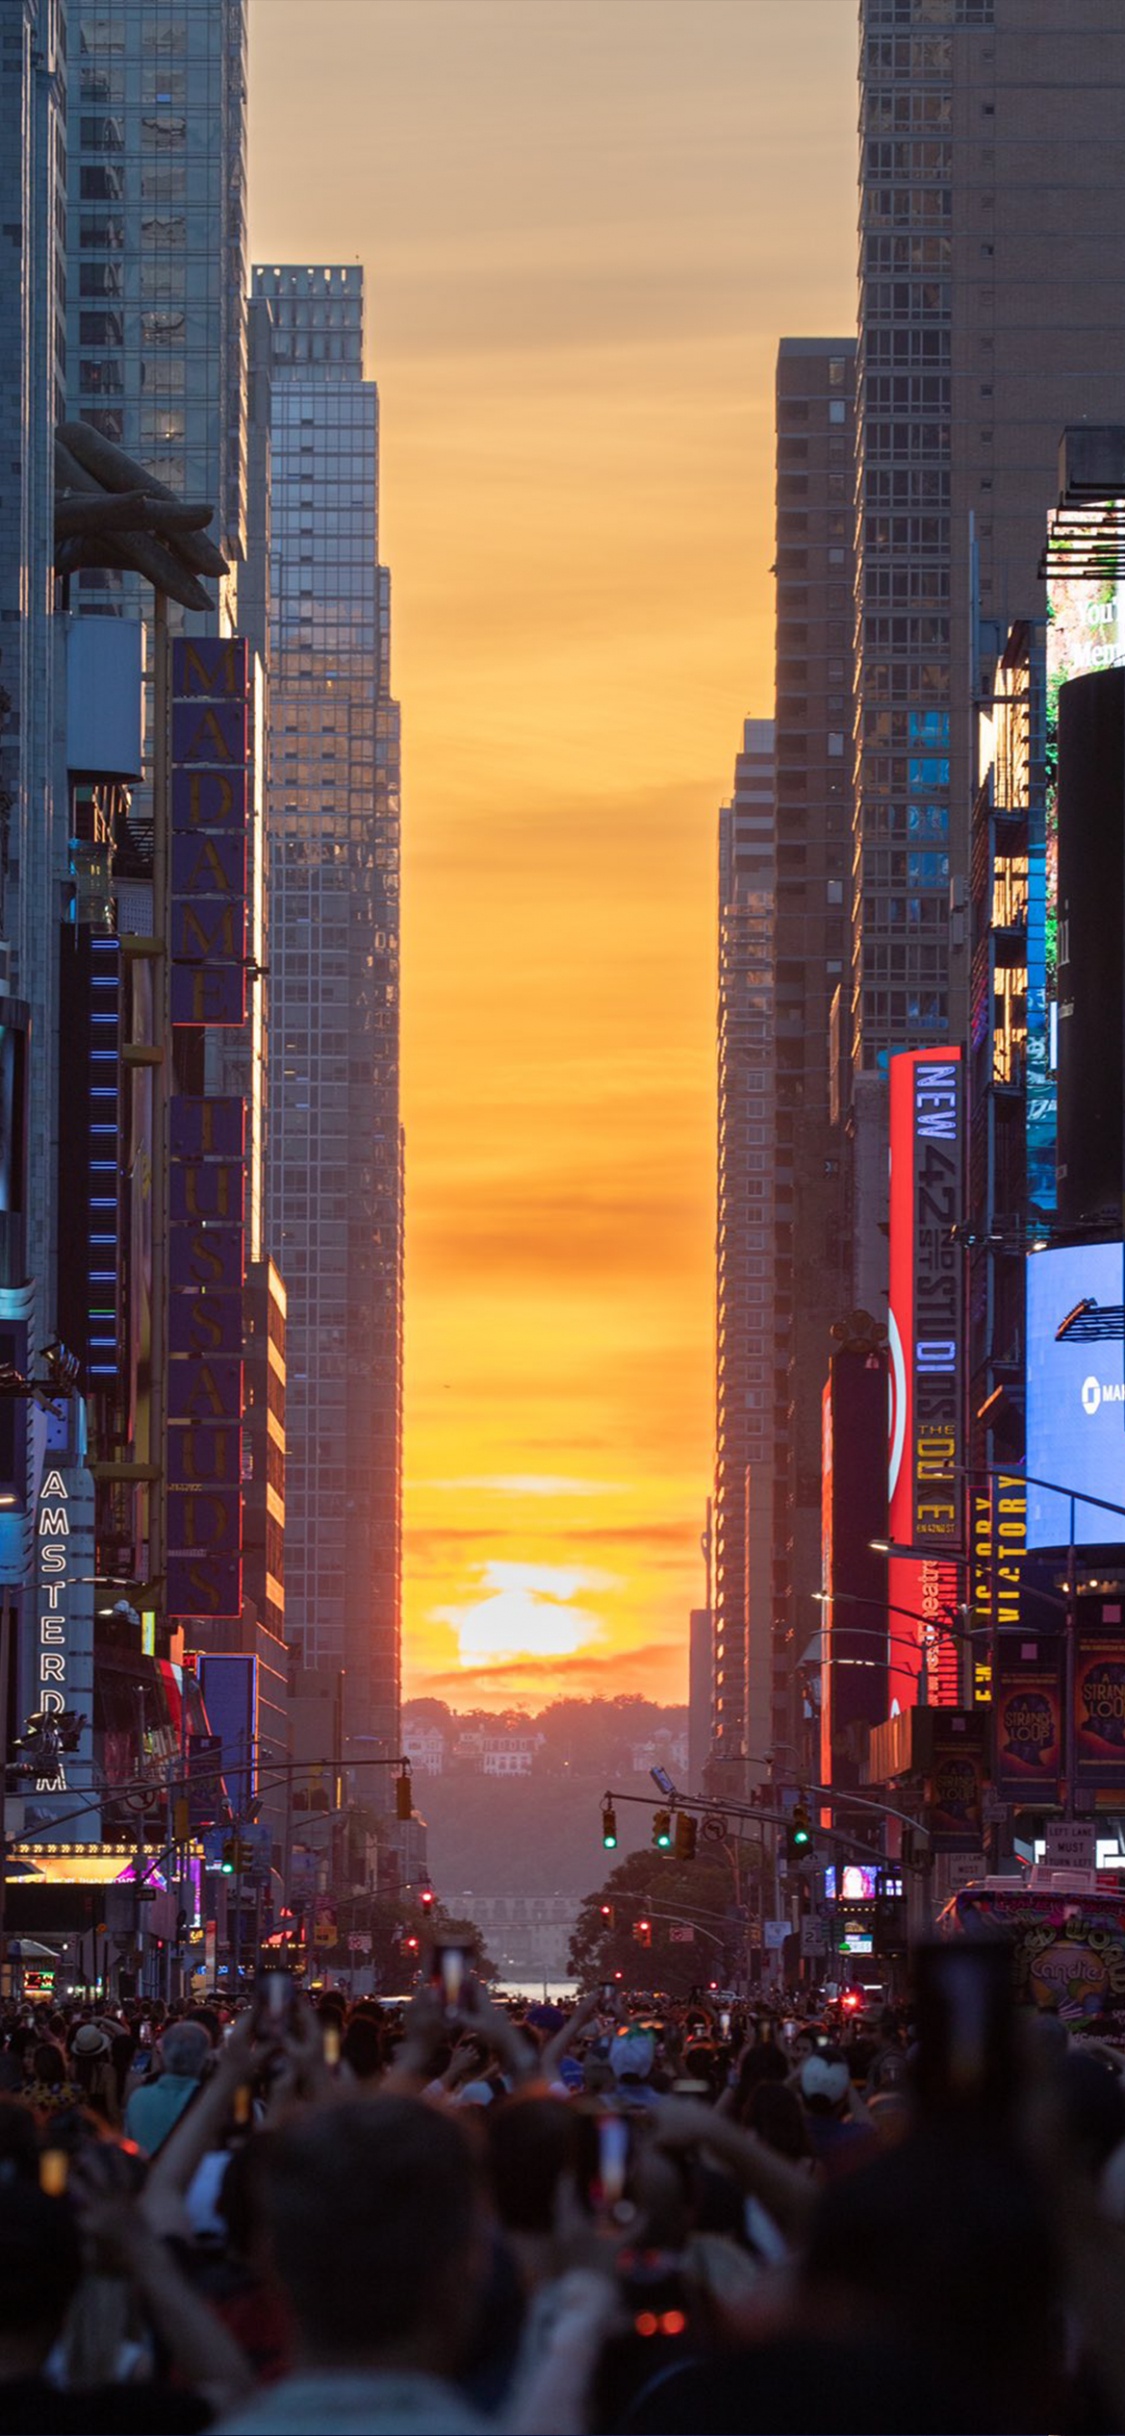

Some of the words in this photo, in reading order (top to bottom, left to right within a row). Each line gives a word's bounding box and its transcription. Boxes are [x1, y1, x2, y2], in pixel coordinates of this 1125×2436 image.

[181, 641, 238, 1021] MADAME
[916, 1065, 956, 1140] NEW
[182, 1101, 231, 1610] TUSSAUDS
[916, 1274, 956, 1419] STUDIOS
[917, 1425, 955, 1435] THE
[998, 1475, 1027, 1622] VICTORY
[36, 1470, 69, 1791] AMSTERDM
[1049, 1827, 1068, 1837] LEFT
[1072, 1828, 1092, 1837] LANE
[1058, 1842, 1084, 1853] MUST
[1031, 1957, 1108, 1984] Candies
